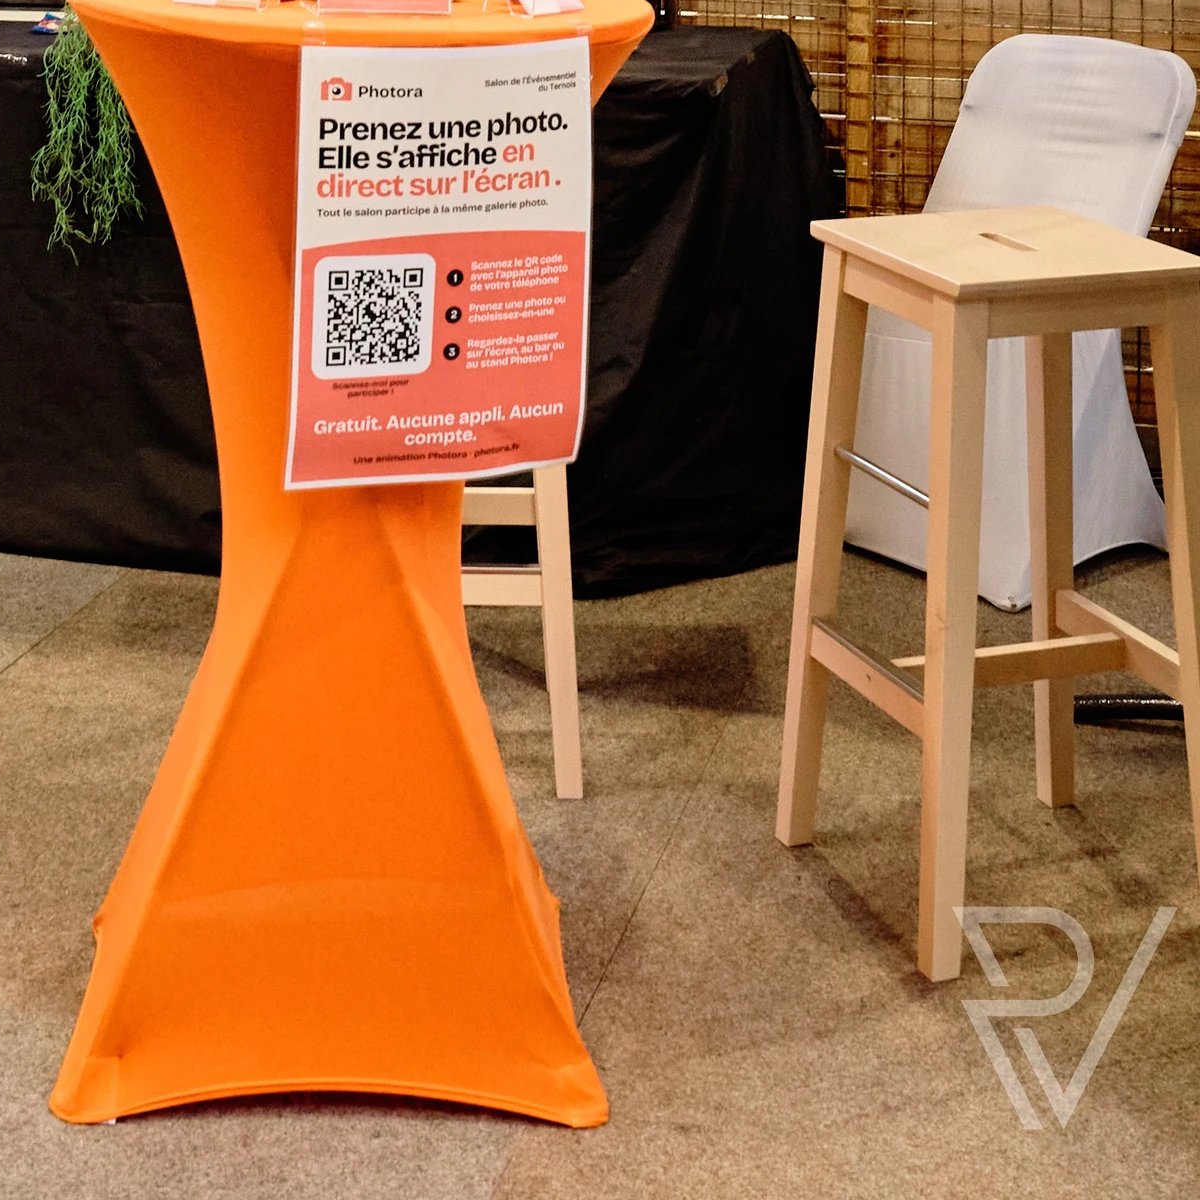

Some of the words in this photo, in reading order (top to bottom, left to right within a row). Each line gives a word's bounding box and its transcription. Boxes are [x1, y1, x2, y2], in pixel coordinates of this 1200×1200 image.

[359, 85, 423, 99] Photora
[485, 79, 509, 88] Salon
[510, 78, 520, 86] de
[539, 84, 548, 92] du
[550, 80, 576, 91] Ternois
[319, 118, 422, 140] Prenez
[429, 120, 481, 139] une
[487, 112, 568, 142] photo.
[319, 144, 369, 169] Elle
[377, 143, 496, 167] s'affiche
[503, 142, 534, 162] en
[317, 172, 403, 198] direct
[410, 175, 456, 195] sur
[318, 208, 340, 217] Tout
[342, 208, 352, 217] le
[354, 208, 382, 217] salon
[385, 205, 430, 218] participe
[432, 206, 439, 214] à
[442, 205, 450, 213] la
[453, 203, 482, 214] même
[485, 200, 517, 212] galerie
[520, 198, 548, 209] photo.
[471, 259, 512, 272] Scannez
[514, 258, 523, 268] le
[525, 256, 539, 267] QR
[541, 253, 563, 264] code
[468, 302, 501, 313] Prenez
[504, 301, 523, 311] une
[525, 297, 553, 311] photo
[555, 296, 566, 305] ou
[468, 306, 555, 324] choisissez-en-une
[313, 416, 382, 435] Gratuit.
[386, 412, 454, 431] Aucune
[459, 406, 505, 427] appli.
[509, 401, 564, 420] Aucun
[404, 426, 477, 447] compte.
